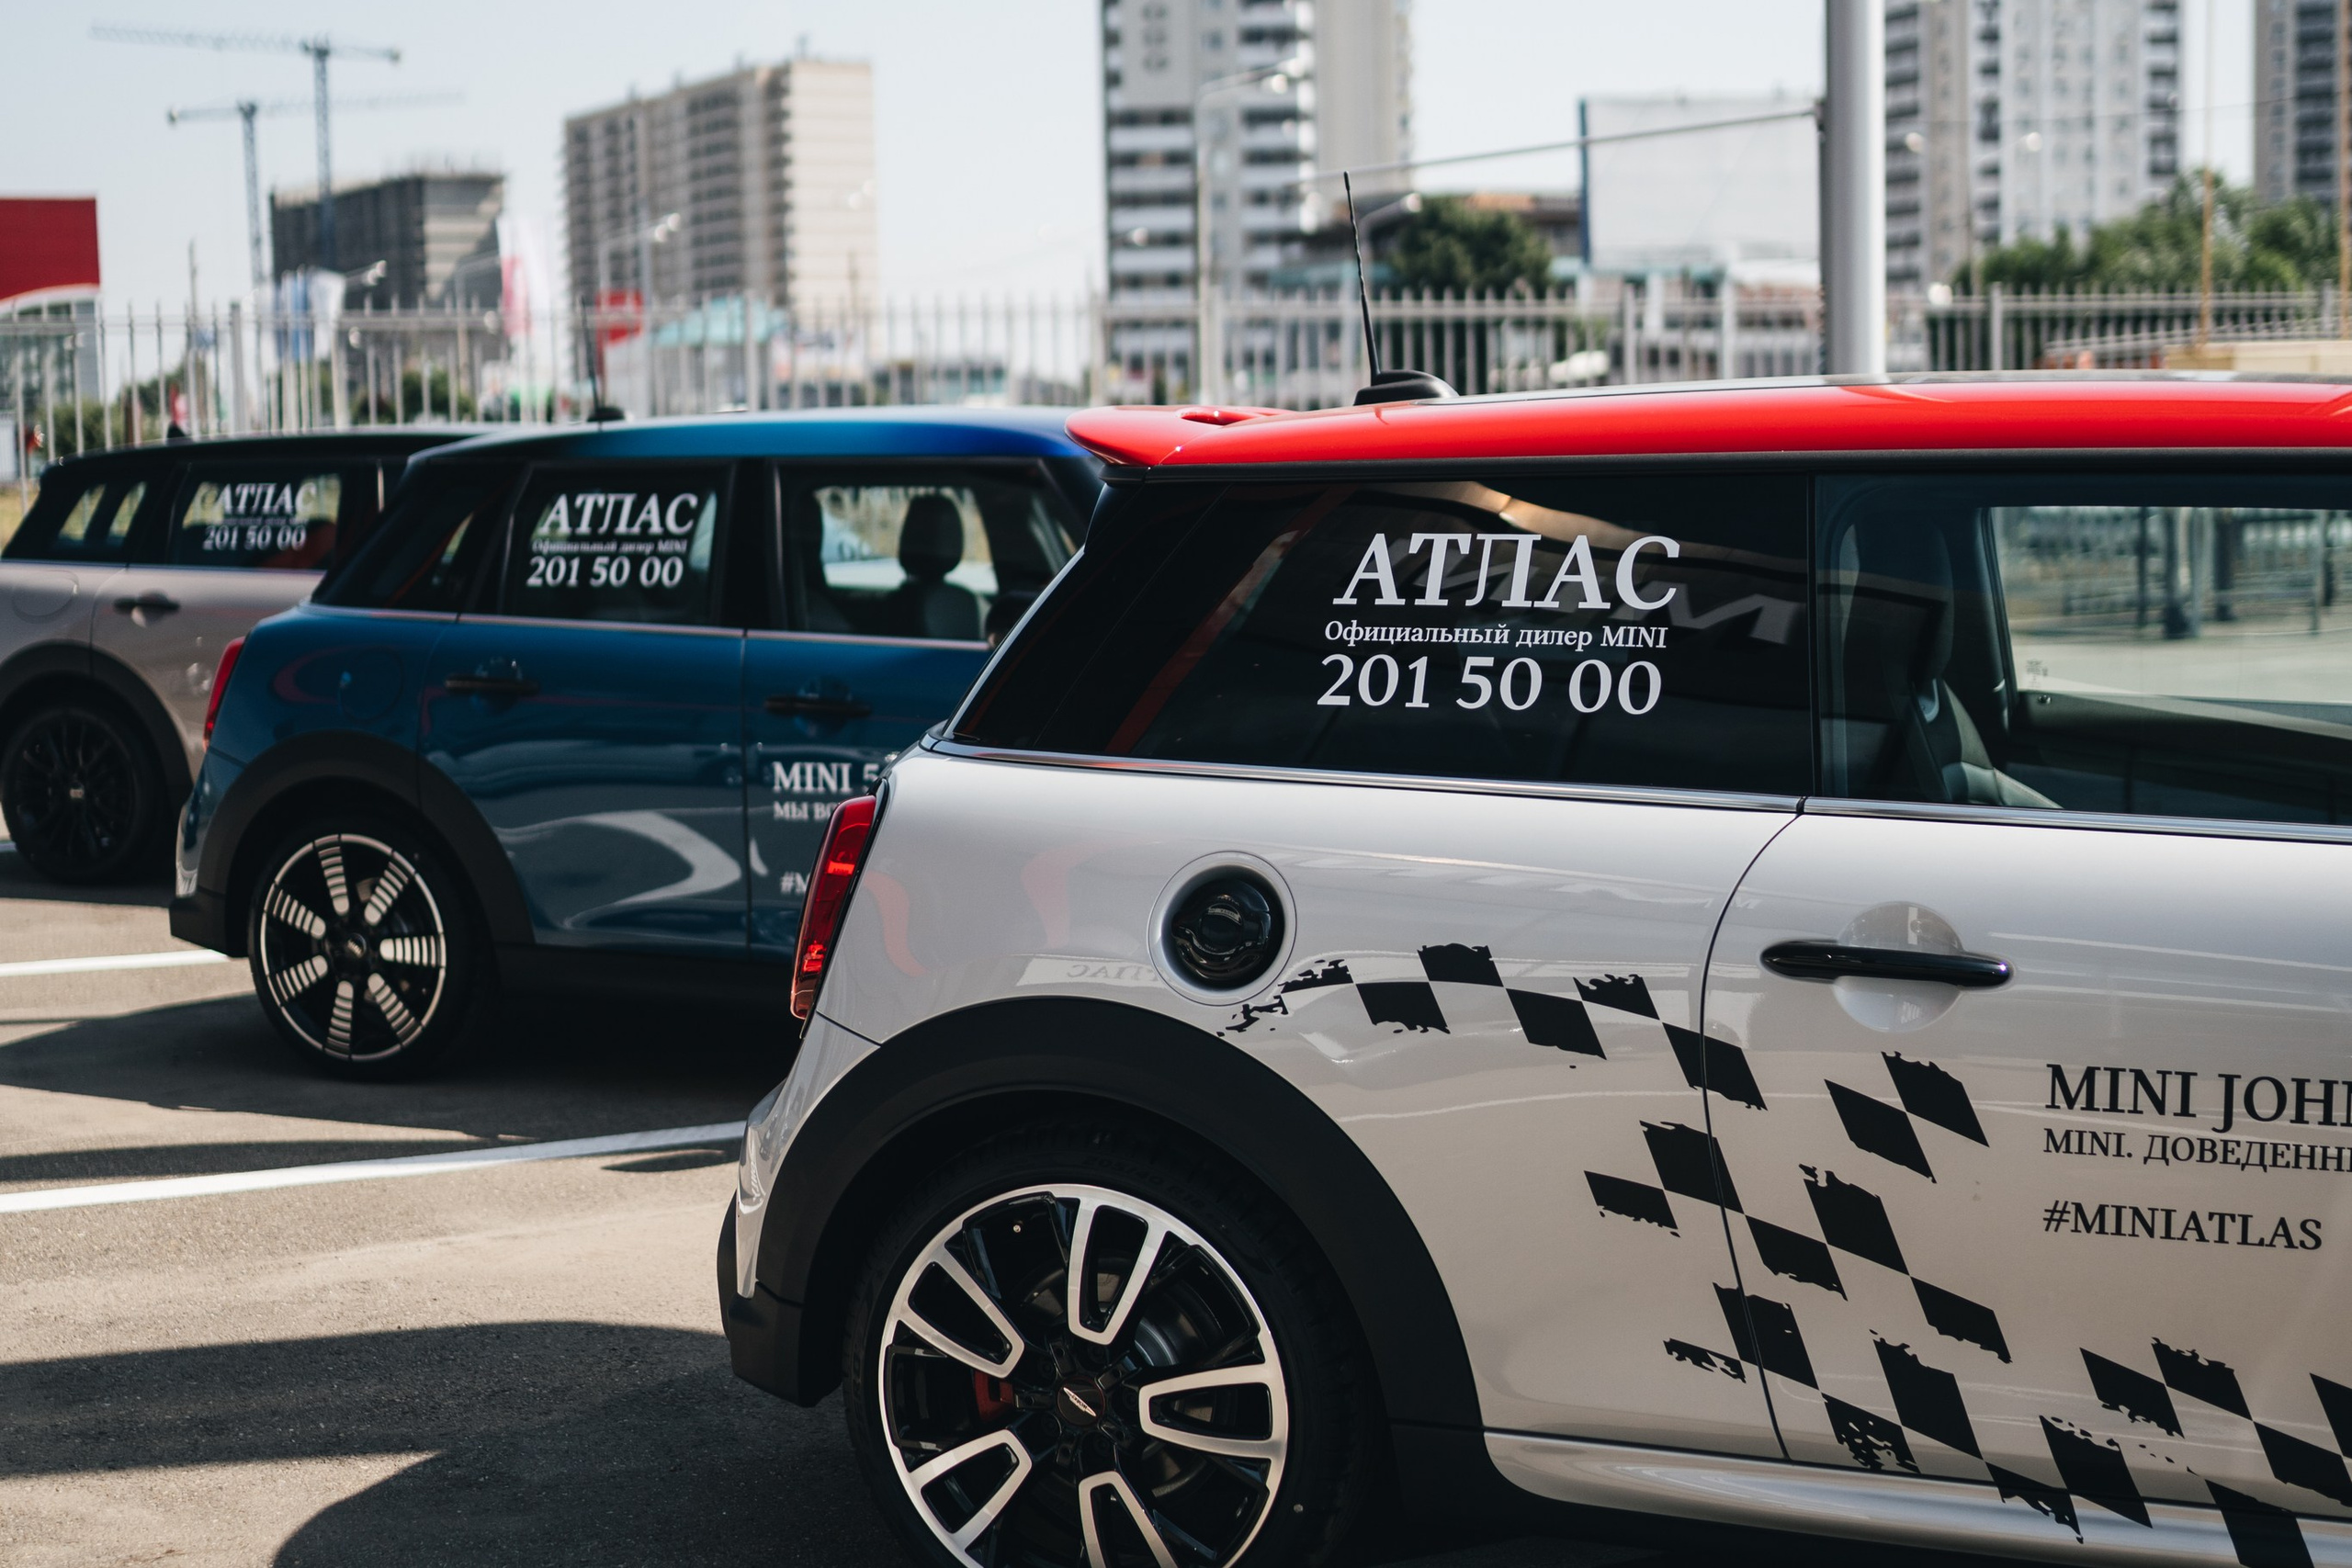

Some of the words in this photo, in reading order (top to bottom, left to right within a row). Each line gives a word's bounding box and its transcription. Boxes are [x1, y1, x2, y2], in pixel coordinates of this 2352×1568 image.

[210, 482, 318, 515] АТЛАС
[537, 492, 699, 535] АТЛАС
[203, 525, 240, 551] 201
[244, 525, 272, 551] 50
[277, 525, 307, 551] 00
[526, 555, 581, 587] 201
[589, 556, 632, 588] 50
[639, 556, 684, 588] 00
[1332, 533, 1680, 611] АТЛАС
[1325, 620, 1510, 648] Официальный
[1516, 629, 1593, 652] дилер
[1600, 626, 1669, 649] MINI
[1317, 654, 1430, 708] 201
[1456, 656, 1543, 711] 50
[1569, 659, 1662, 716] 00
[773, 761, 853, 795] MINI
[774, 801, 809, 821] МЫ
[2045, 1063, 2198, 1119] MINI
[2043, 1128, 2133, 1159] MINI.
[2042, 1200, 2324, 1251] #MINIATLAS
